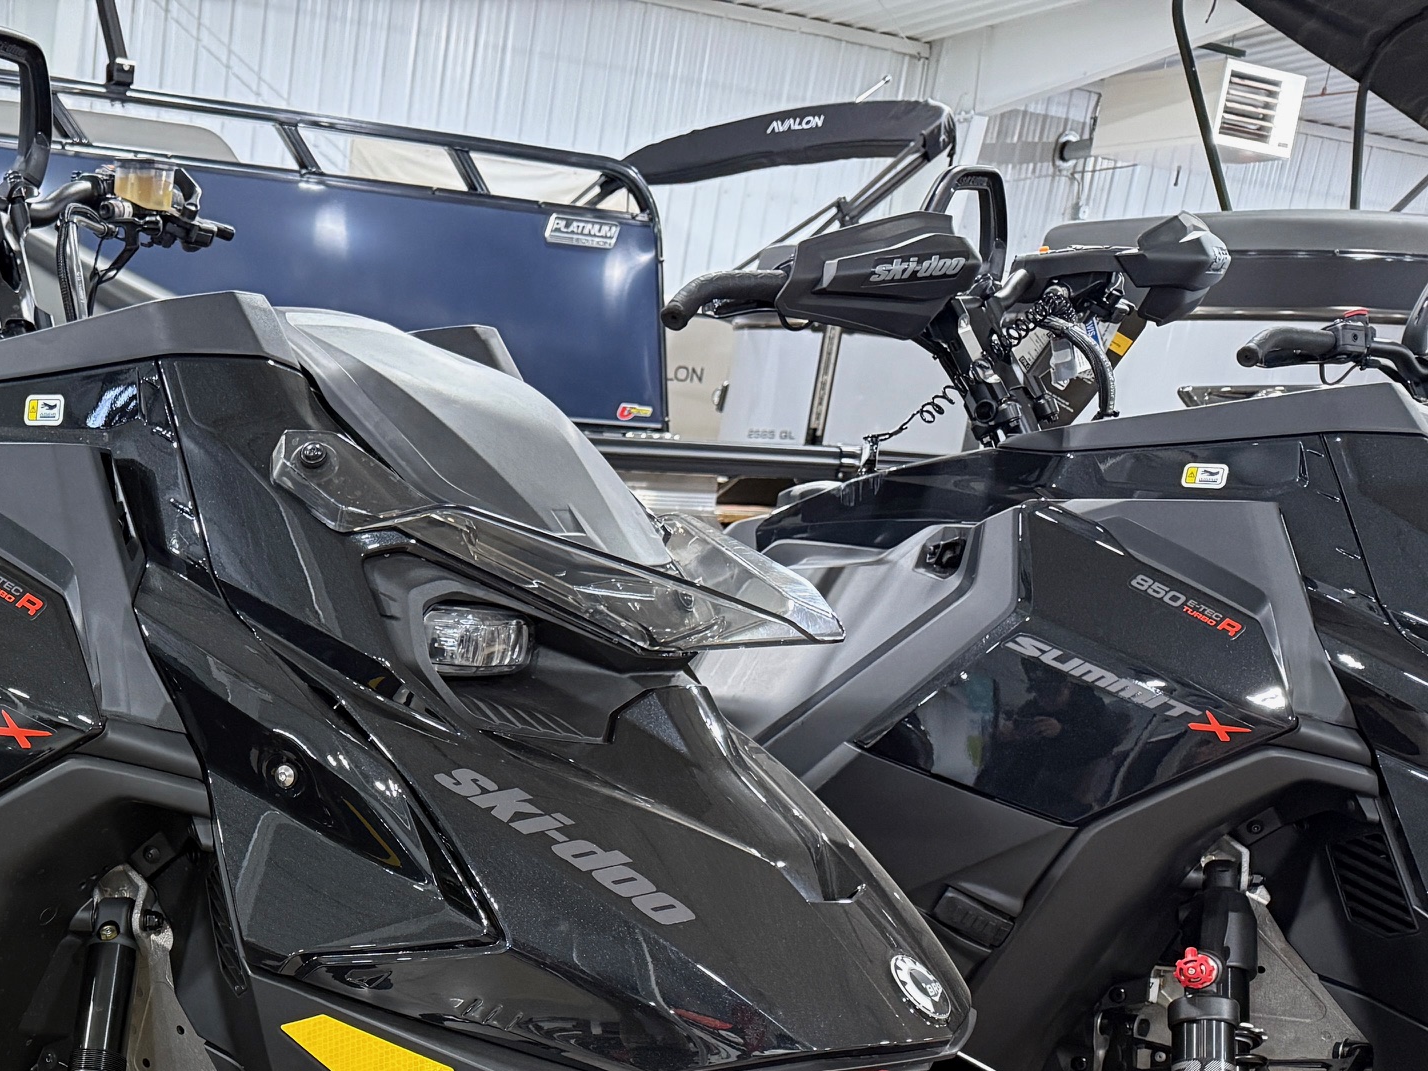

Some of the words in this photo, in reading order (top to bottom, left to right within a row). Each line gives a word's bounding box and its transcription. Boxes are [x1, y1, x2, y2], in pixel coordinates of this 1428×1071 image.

[765, 114, 826, 135] AVALON
[553, 219, 617, 238] PLATINUM
[869, 254, 967, 282] ski-doo
[15, 593, 44, 616] R
[1130, 574, 1186, 607] 850
[1186, 599, 1223, 621] E-TEC
[1182, 605, 1217, 627] TURBO
[1216, 617, 1242, 637] R
[1187, 710, 1252, 742] X
[433, 768, 696, 926] ski-doo
